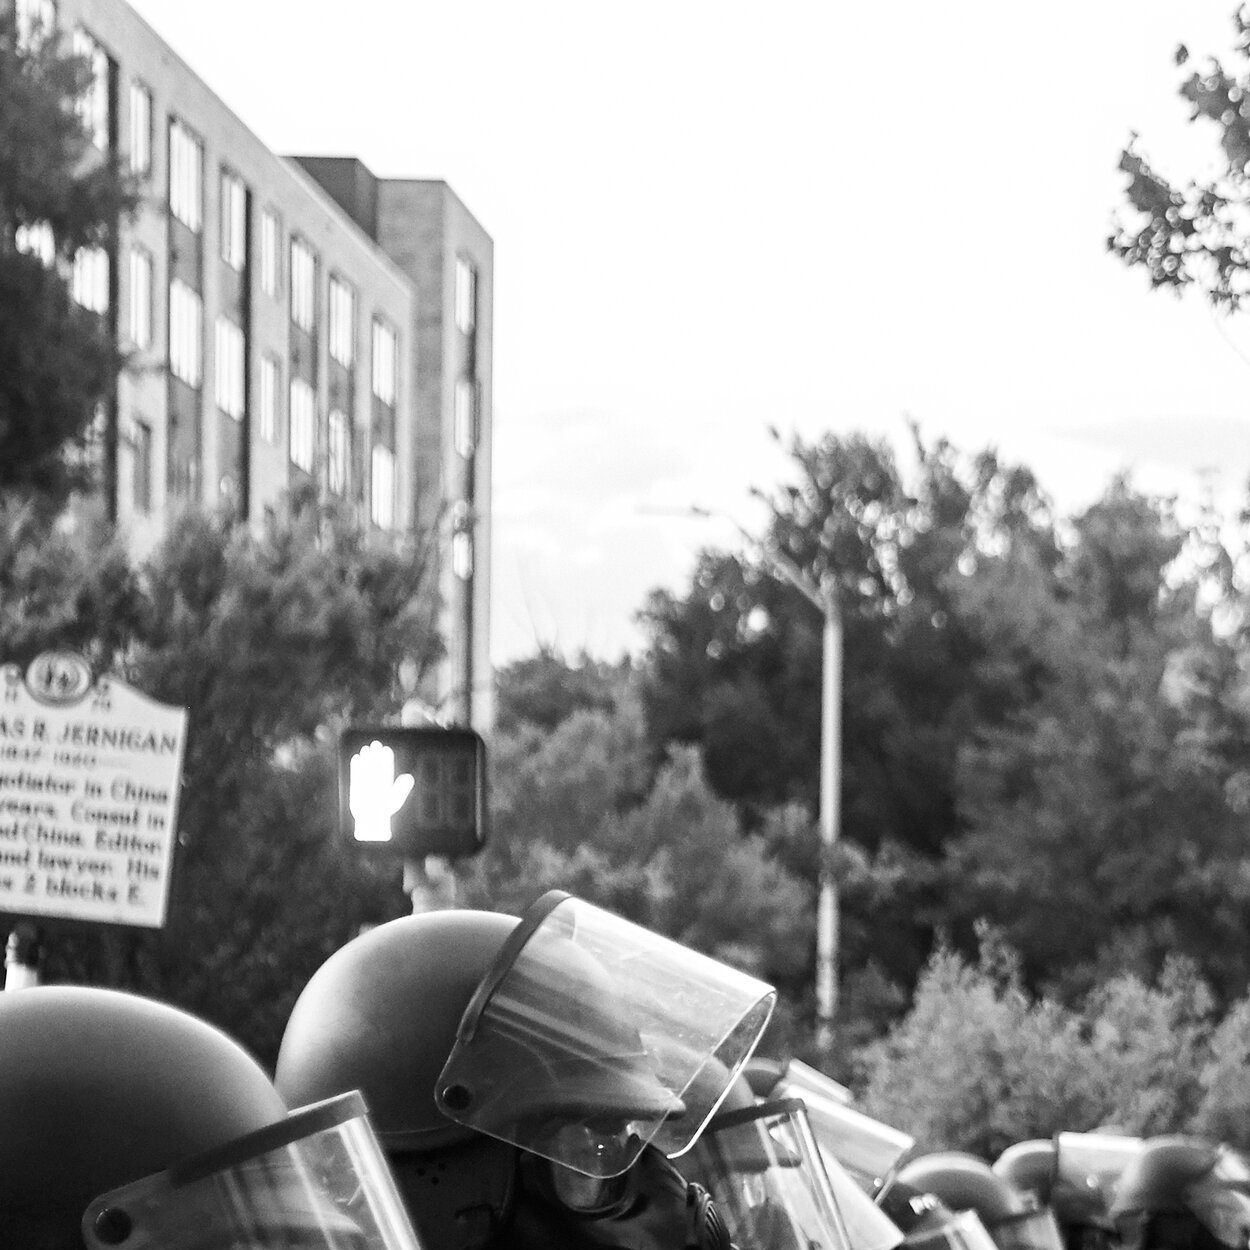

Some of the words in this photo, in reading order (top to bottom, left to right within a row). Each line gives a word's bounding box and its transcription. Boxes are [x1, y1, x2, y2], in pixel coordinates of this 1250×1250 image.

[59, 723, 176, 753] JERNIGAN
[109, 776, 169, 804] China
[71, 798, 139, 828] Consul
